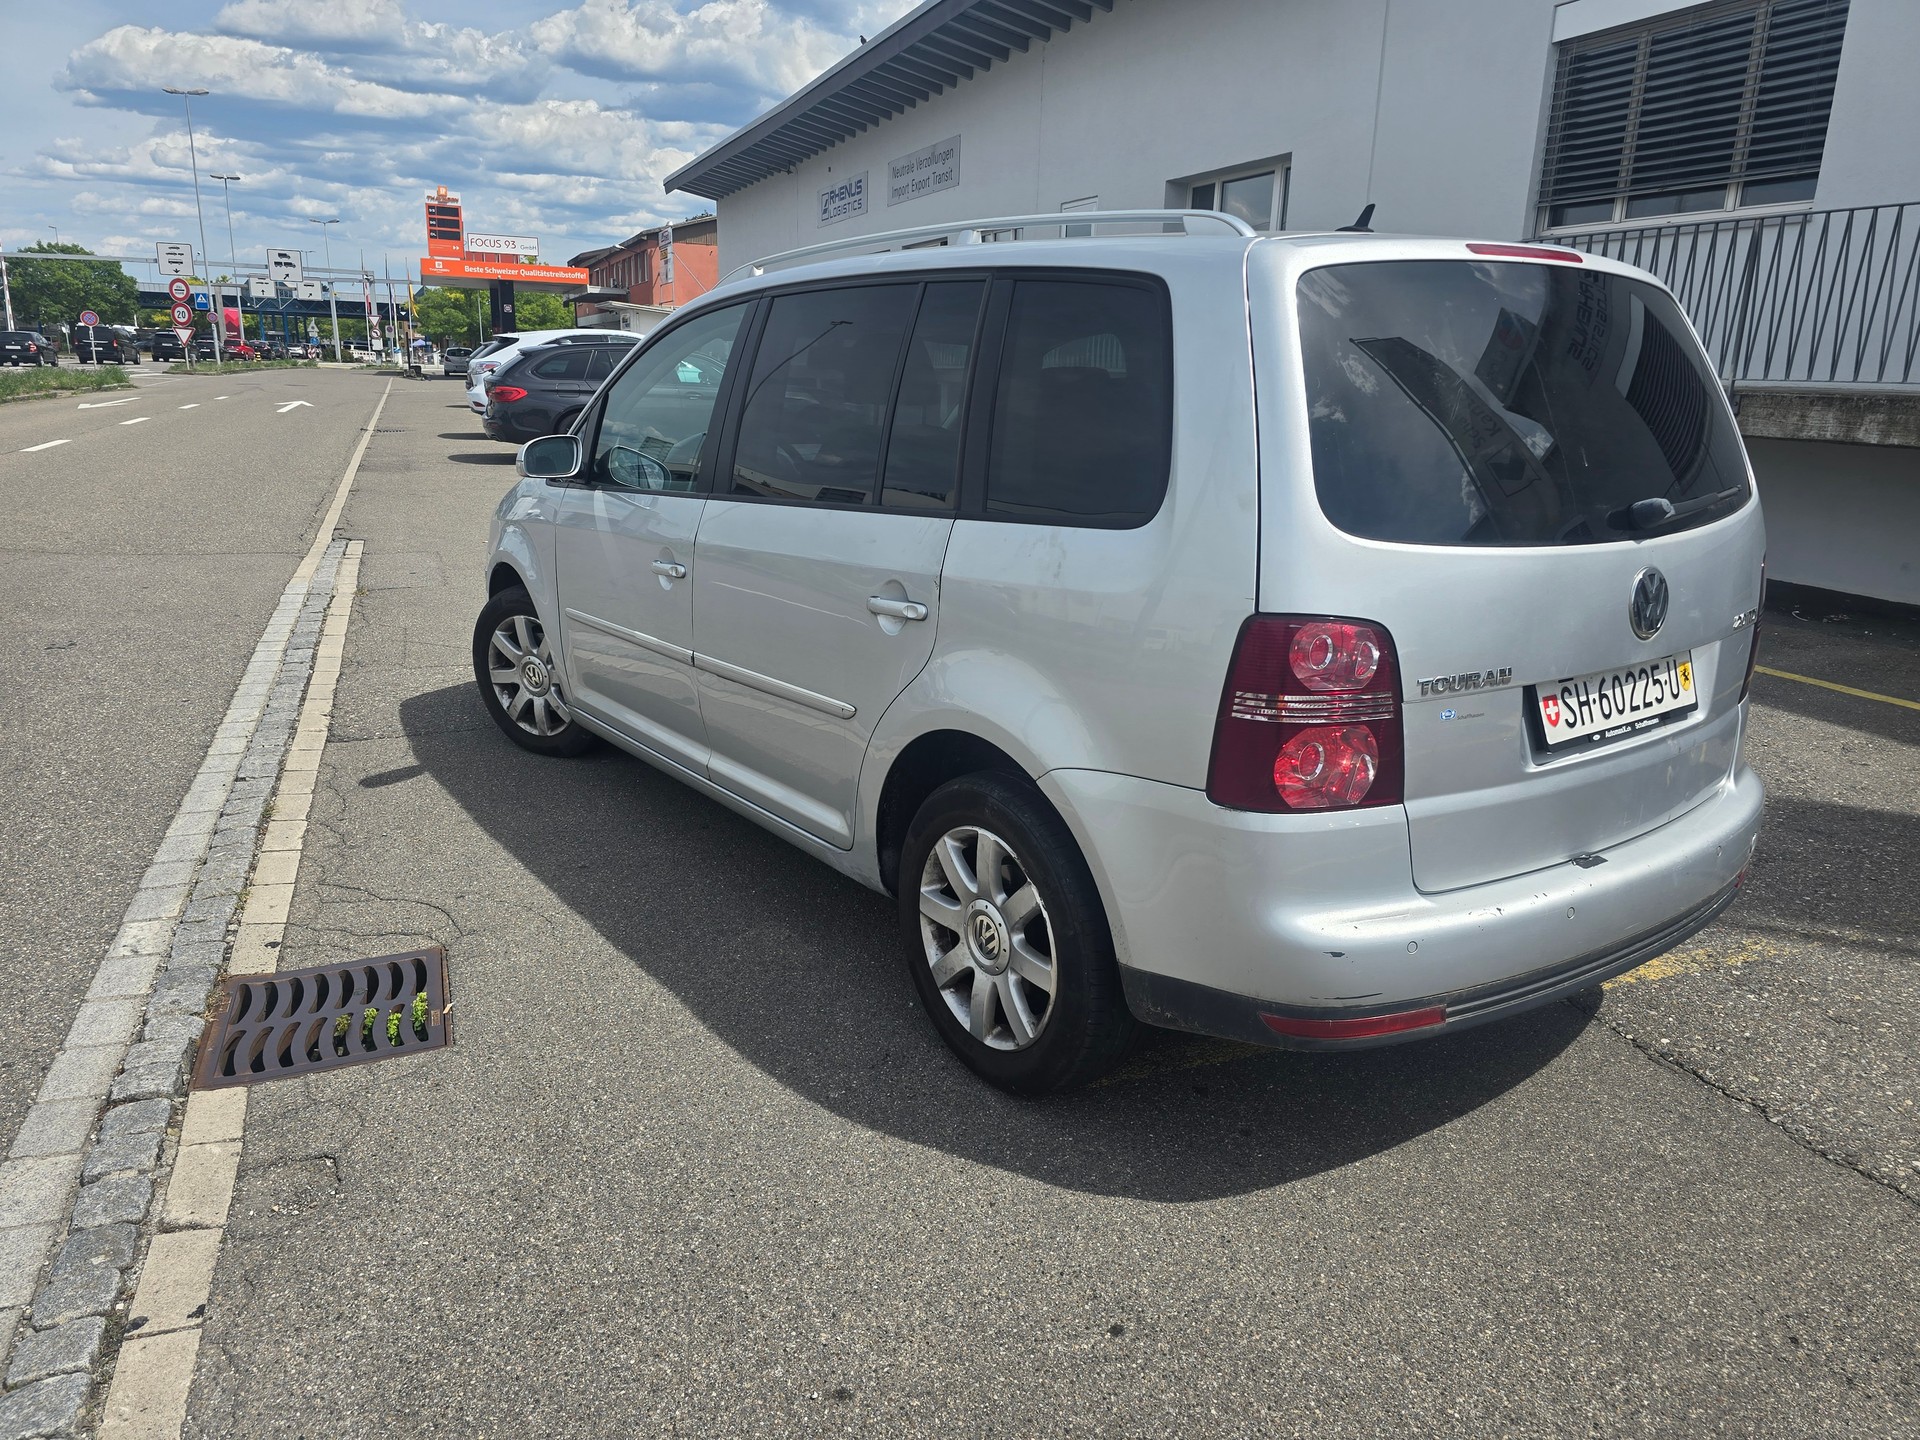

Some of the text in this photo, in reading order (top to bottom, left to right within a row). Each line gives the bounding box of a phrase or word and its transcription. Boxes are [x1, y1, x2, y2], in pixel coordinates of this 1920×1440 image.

[892, 148, 954, 179] Neutrale Verzollungen
[829, 179, 863, 206] RHENUS
[891, 167, 953, 200] Import Export Transit
[829, 198, 863, 219] LOGISTICS
[470, 237, 502, 249] FOCUS
[504, 240, 517, 249] 93
[464, 265, 484, 274] Beste
[484, 266, 519, 276] Schweizer
[176, 310, 186, 319] 20
[1416, 666, 1513, 698] TOURAN
